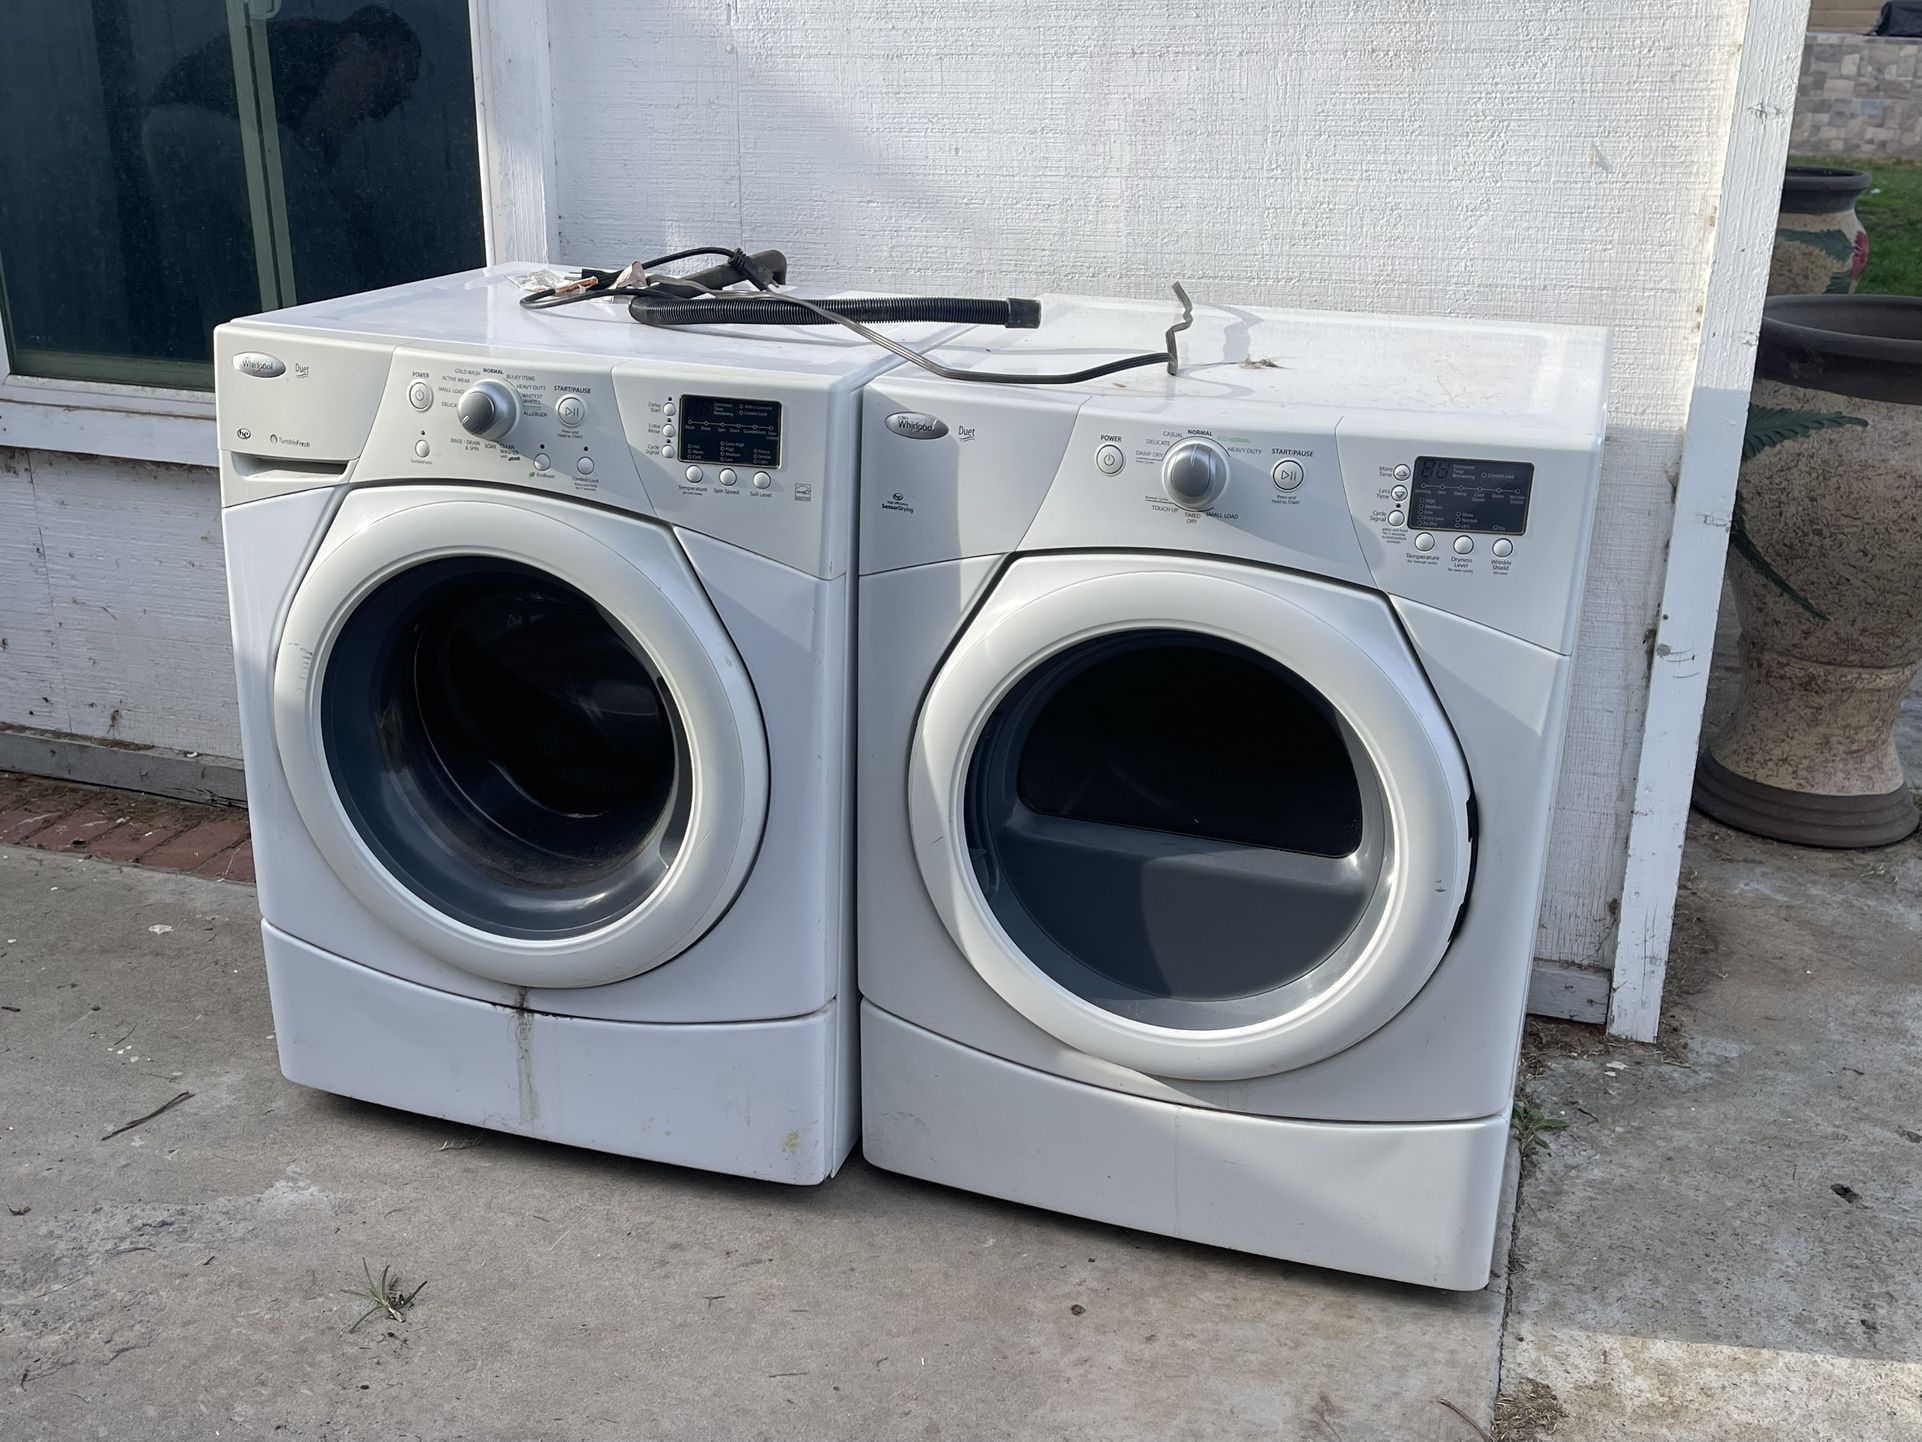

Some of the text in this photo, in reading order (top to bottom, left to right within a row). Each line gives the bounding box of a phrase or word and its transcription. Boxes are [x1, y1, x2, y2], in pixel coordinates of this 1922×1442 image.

[243, 359, 274, 371] Whirlpool
[295, 363, 309, 374] Duet
[554, 386, 591, 394] START/PAUSE
[959, 425, 975, 436] Duet
[1272, 448, 1314, 457] START/PAUSE
[882, 504, 914, 513] SensorDrying
[1370, 516, 1386, 524] Signal
[1406, 553, 1440, 561] Temperature
